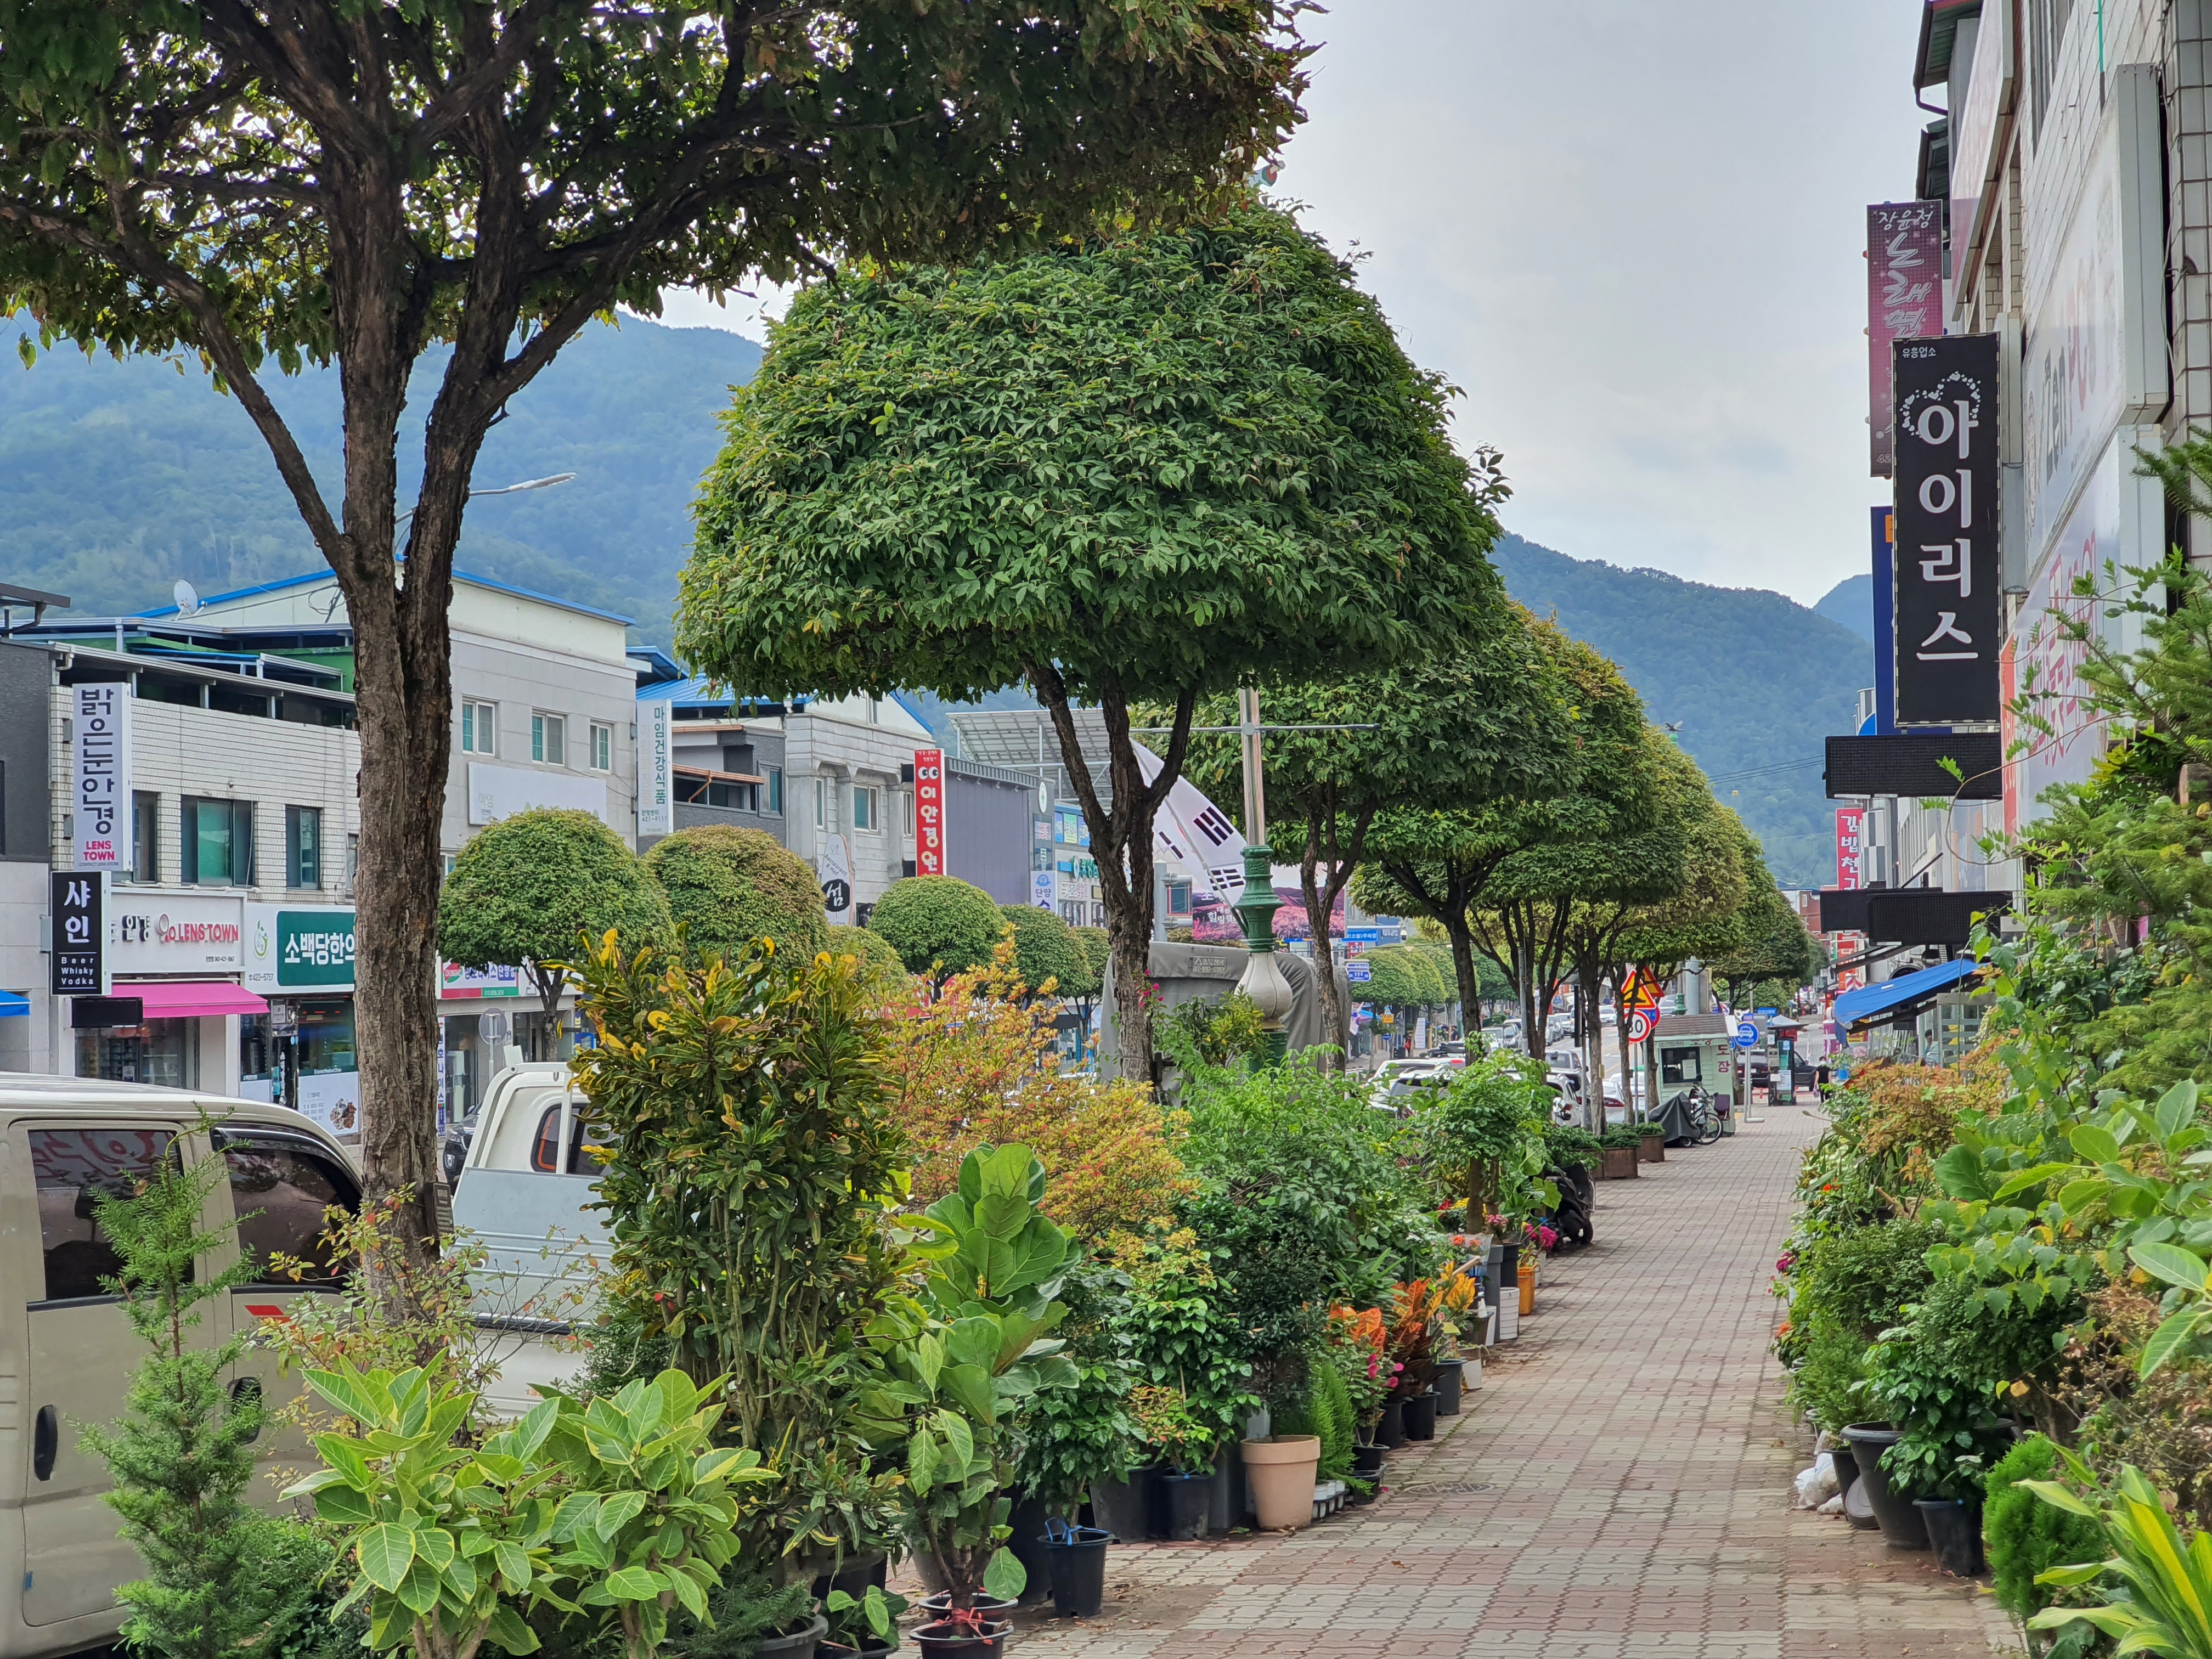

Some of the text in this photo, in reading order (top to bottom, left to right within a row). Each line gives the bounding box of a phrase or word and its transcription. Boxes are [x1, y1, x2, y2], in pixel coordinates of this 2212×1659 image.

[1878, 210, 1933, 231] 장윤정
[1902, 346, 1937, 359] 유흥업소
[1916, 399, 1979, 661] 아이리스
[81, 688, 114, 835] 밝은눈안경
[654, 706, 666, 805] 마임건강식품
[478, 793, 493, 808] 마임
[920, 786, 939, 871] 이안경원
[86, 840, 112, 850] LENS
[83, 851, 115, 861] TOWN
[825, 854, 848, 877] Restaurant
[1035, 888, 1052, 898] 단양
[64, 879, 91, 944] 샤인
[178, 923, 205, 941] LENS
[206, 923, 239, 941] TOWN
[61, 967, 93, 975] Whisky
